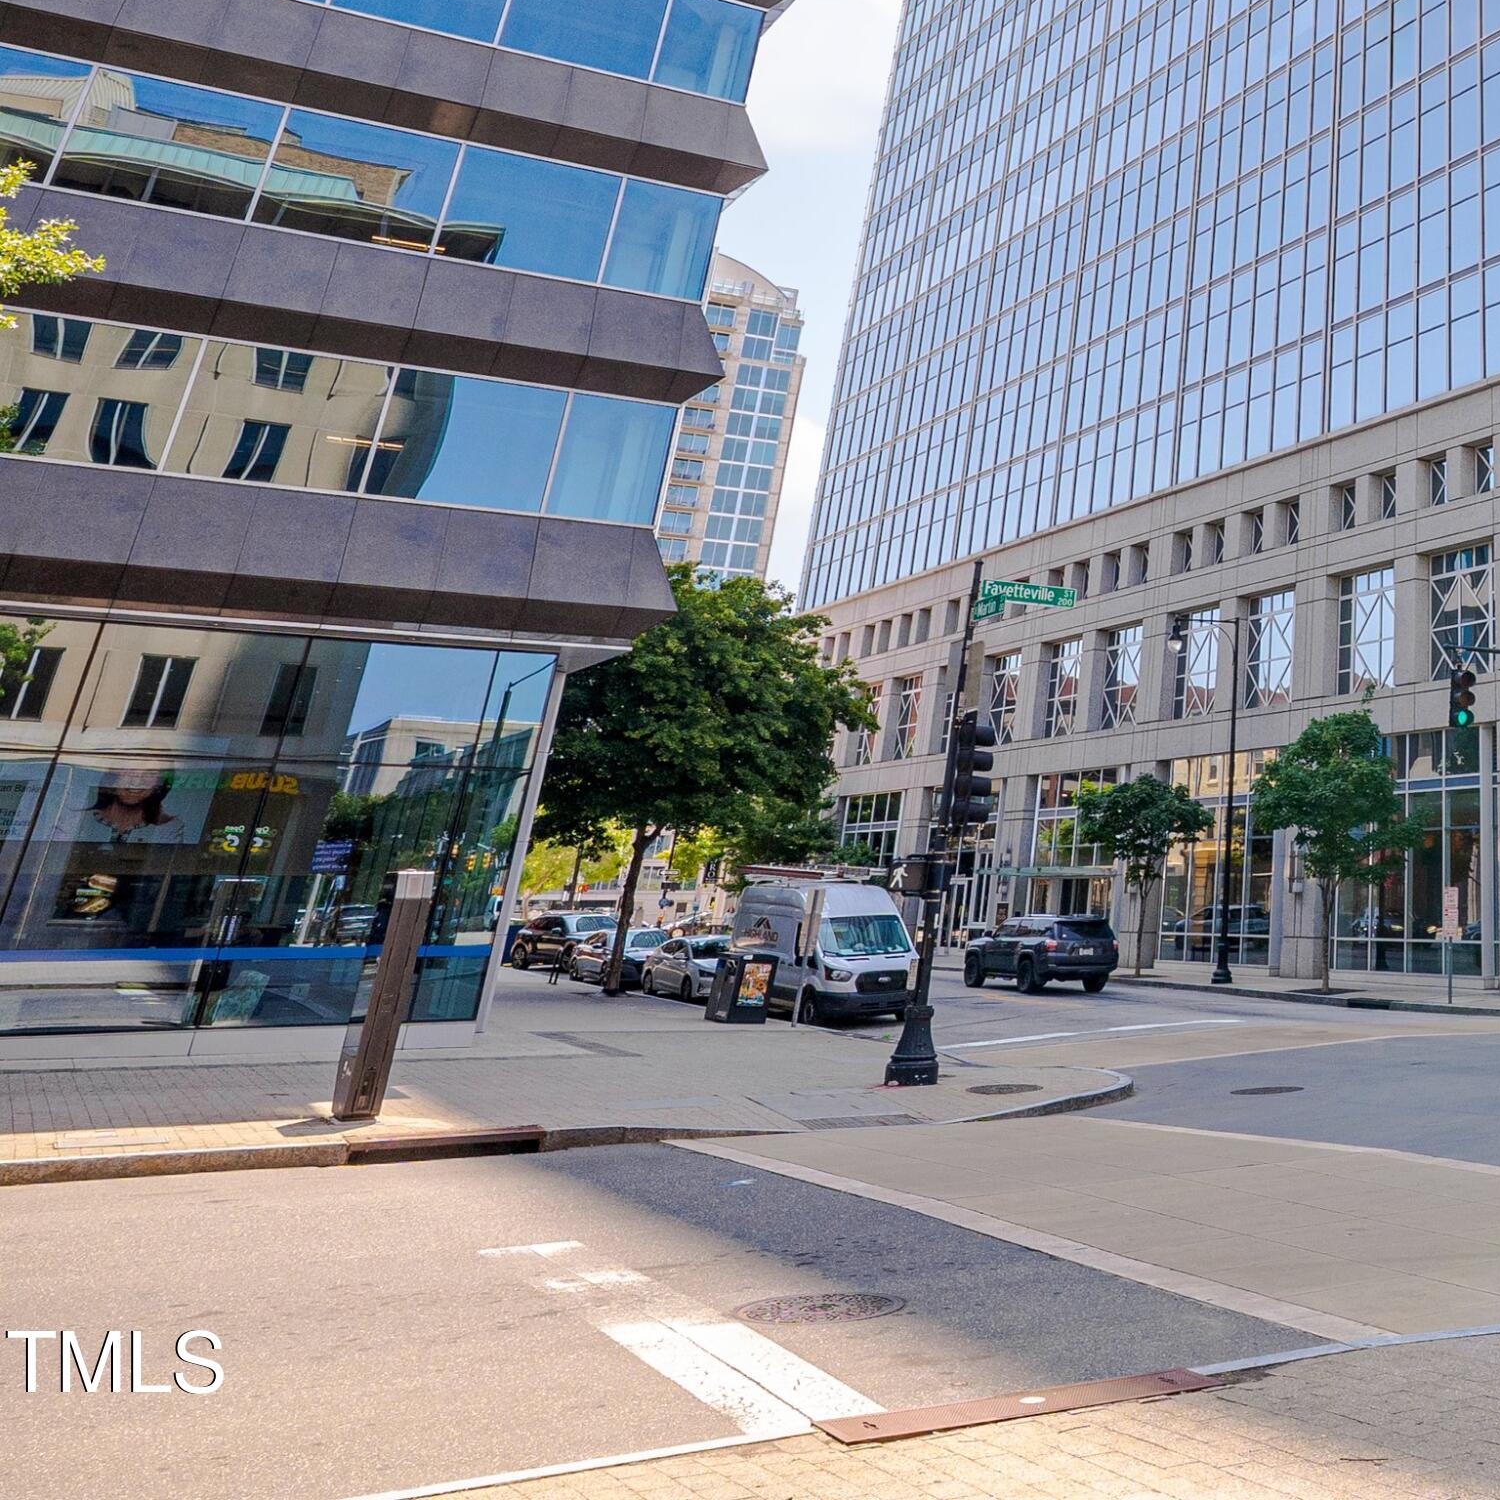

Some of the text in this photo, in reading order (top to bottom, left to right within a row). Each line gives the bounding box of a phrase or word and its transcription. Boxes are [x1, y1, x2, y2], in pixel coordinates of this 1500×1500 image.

[984, 581, 1074, 602] Fayetteville ST
[1057, 597, 1073, 607] 200
